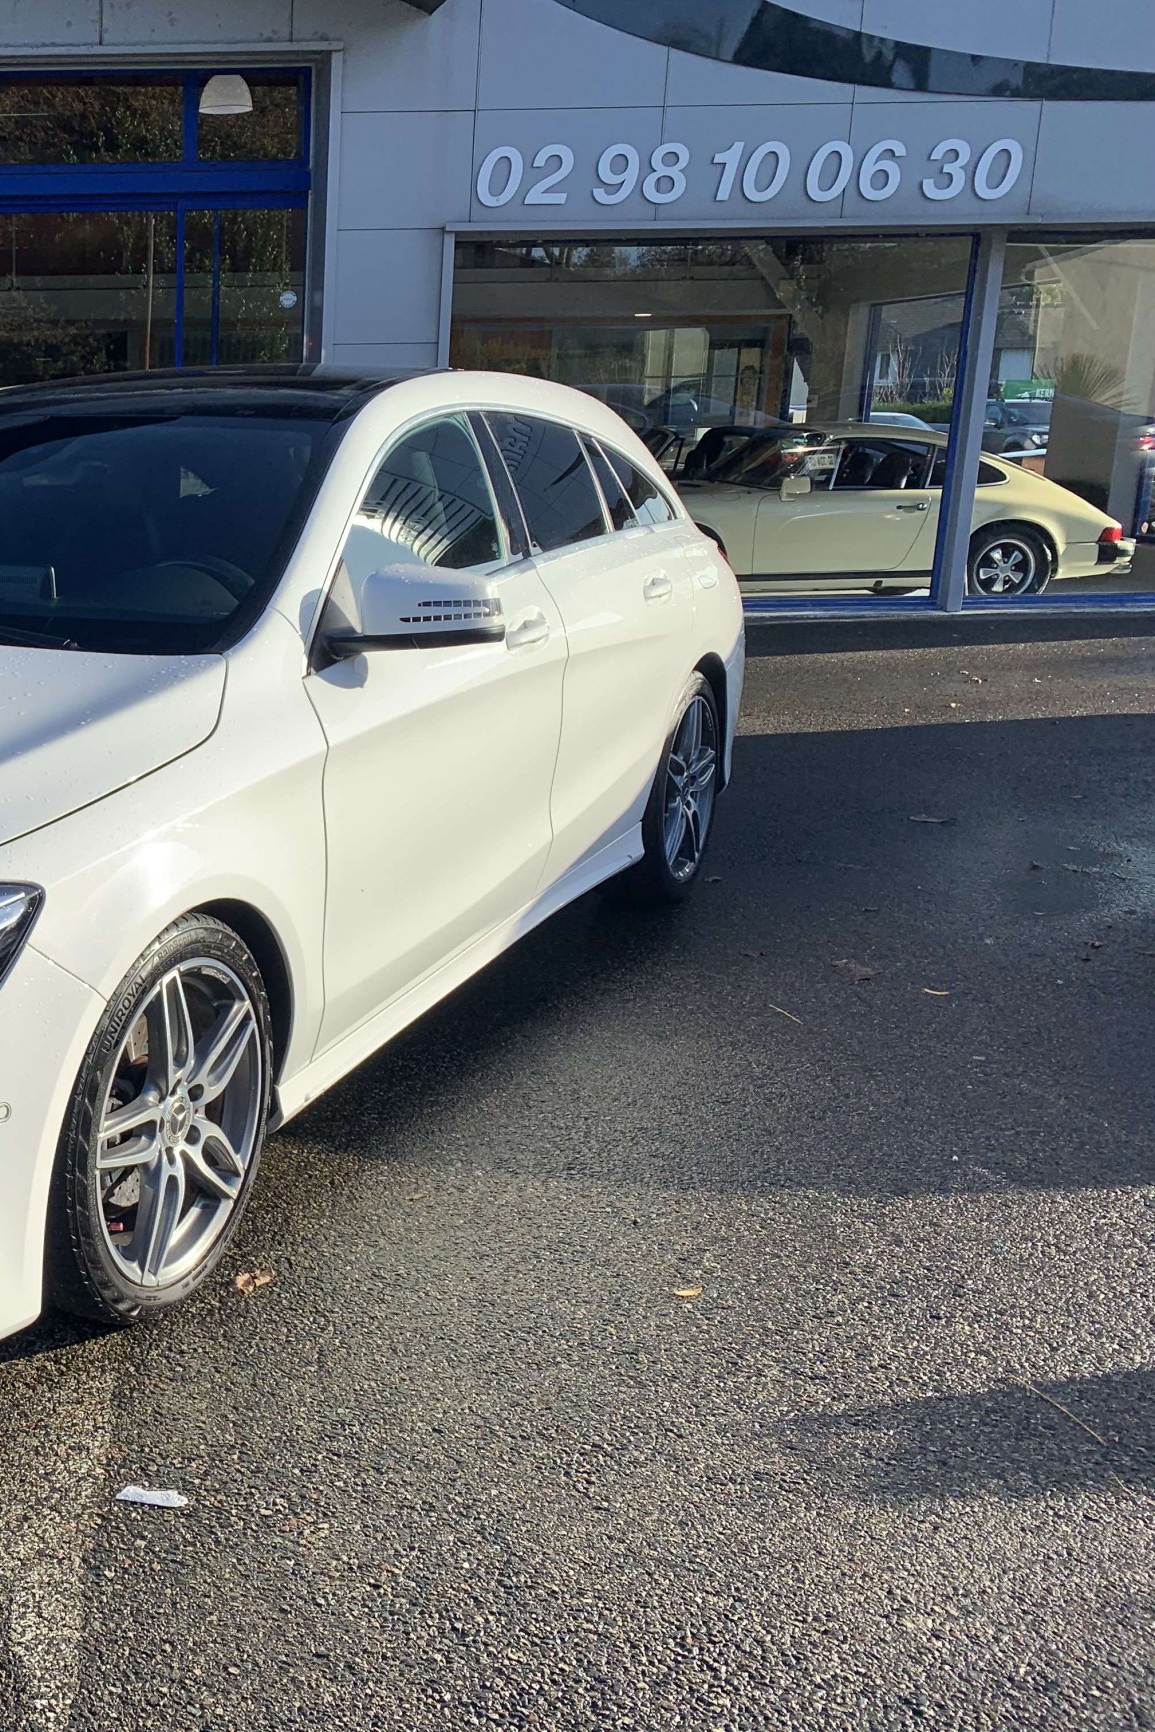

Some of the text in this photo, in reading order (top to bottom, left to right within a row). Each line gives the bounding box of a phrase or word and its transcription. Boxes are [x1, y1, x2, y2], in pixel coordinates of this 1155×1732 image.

[476, 138, 1023, 206] 02 98 10 06 30
[102, 975, 146, 1053] UNIROYAL
